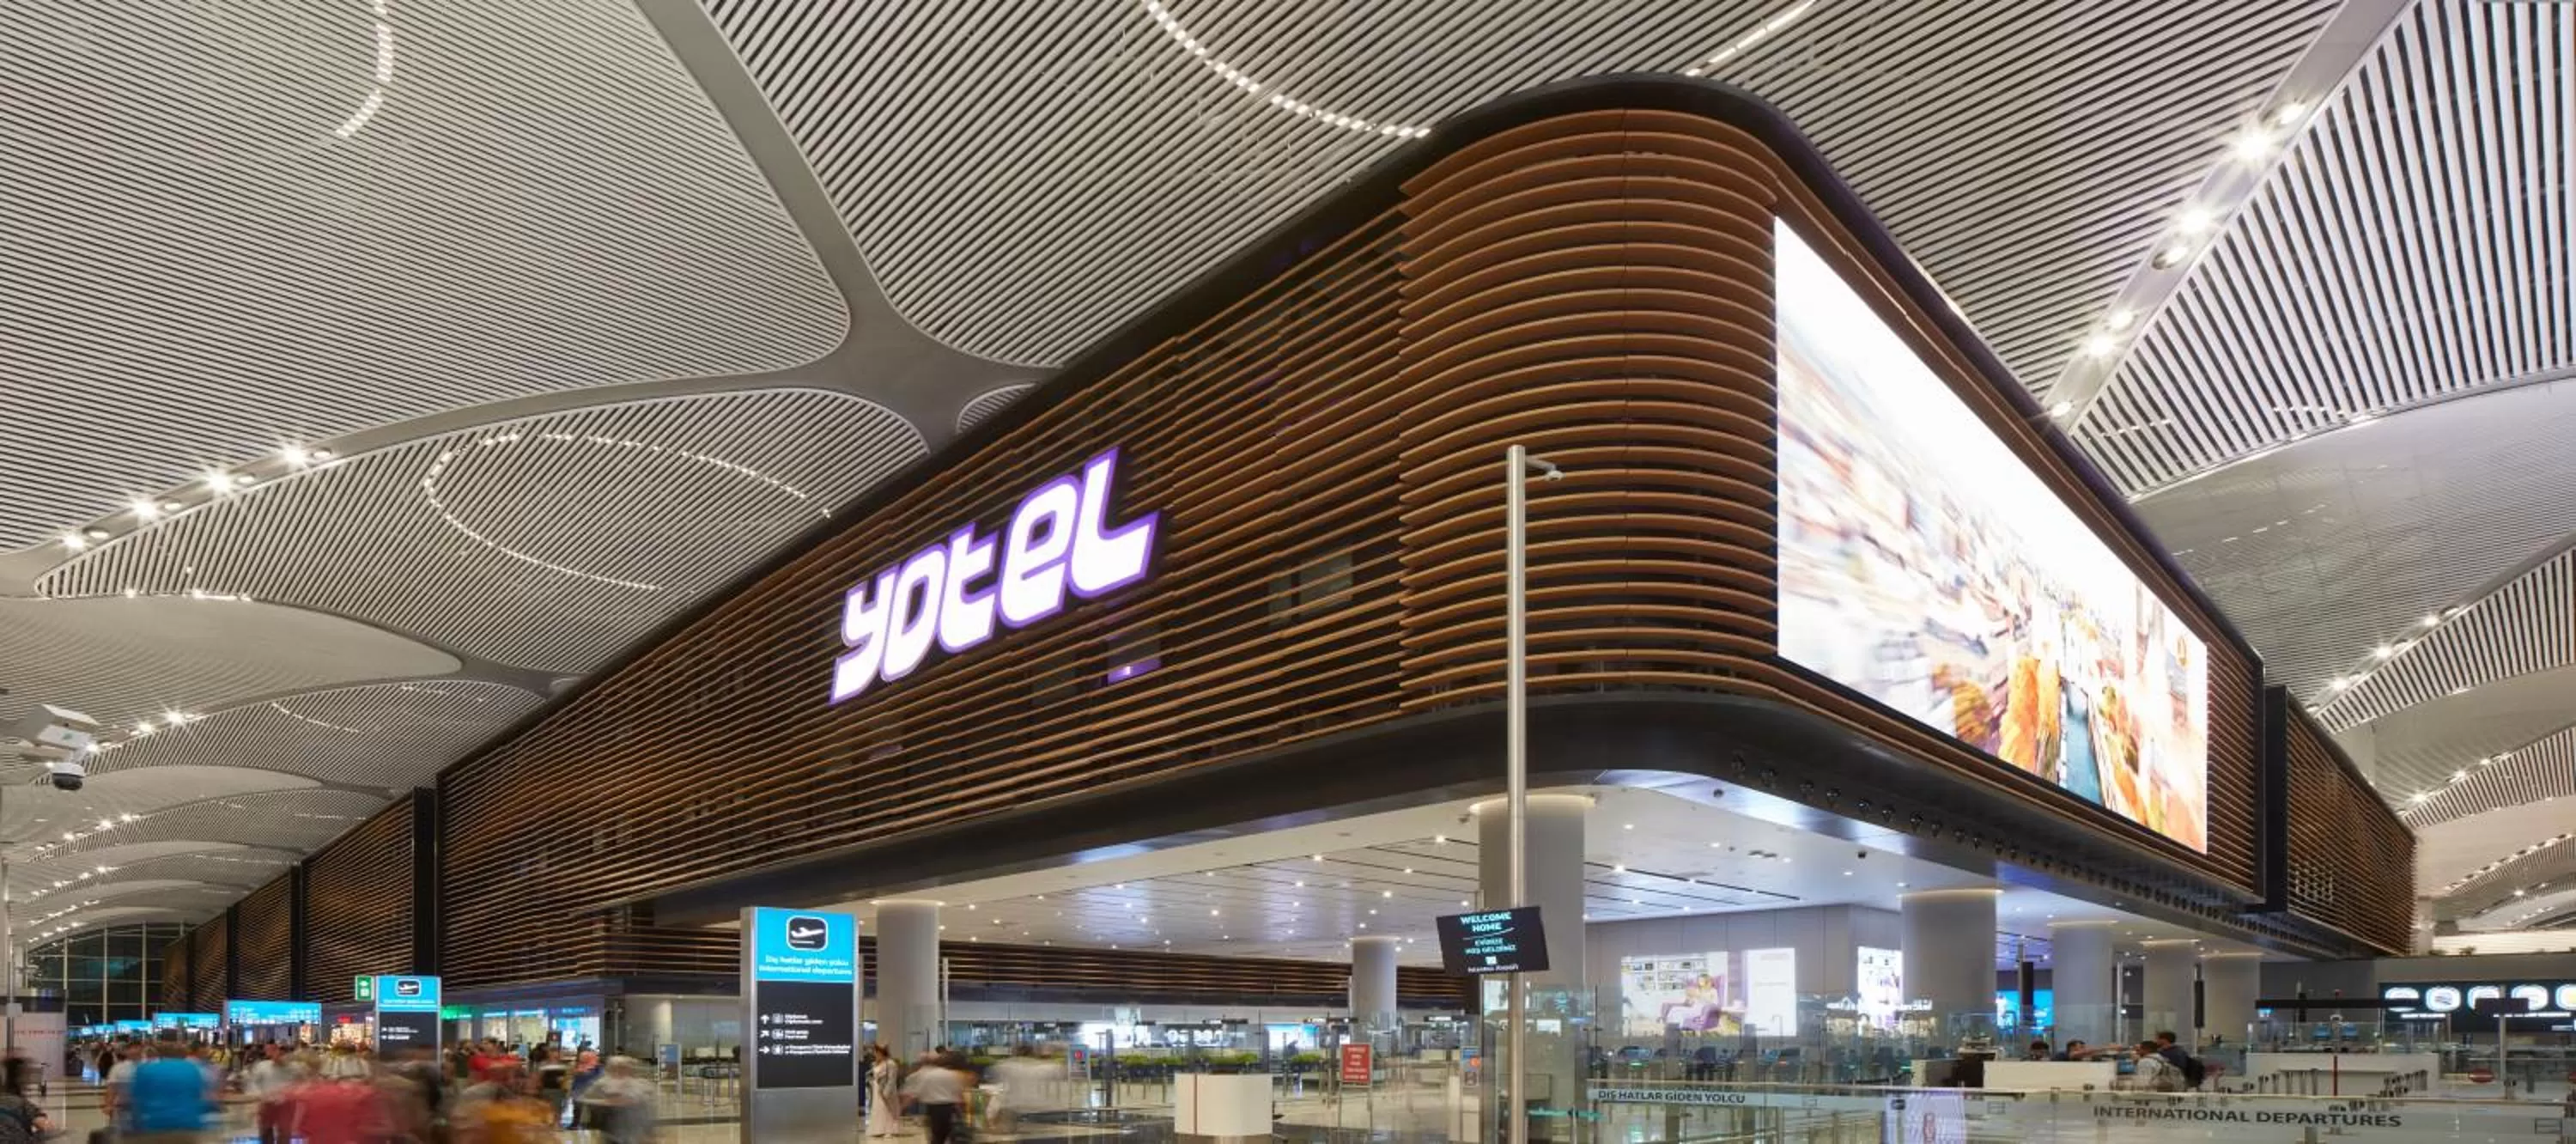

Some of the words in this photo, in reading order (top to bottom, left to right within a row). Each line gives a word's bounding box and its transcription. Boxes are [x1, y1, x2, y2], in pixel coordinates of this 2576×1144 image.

[1461, 911, 1512, 925] WELCOME
[1473, 922, 1503, 933] HOME
[1618, 1091, 1663, 1101] HATLAR
[1665, 1091, 1702, 1102] GİDEN
[1704, 1092, 1746, 1104] YOLCU
[2093, 1105, 2249, 1123] INTERNATIONAL
[2256, 1111, 2403, 1128] DEPARTURES
